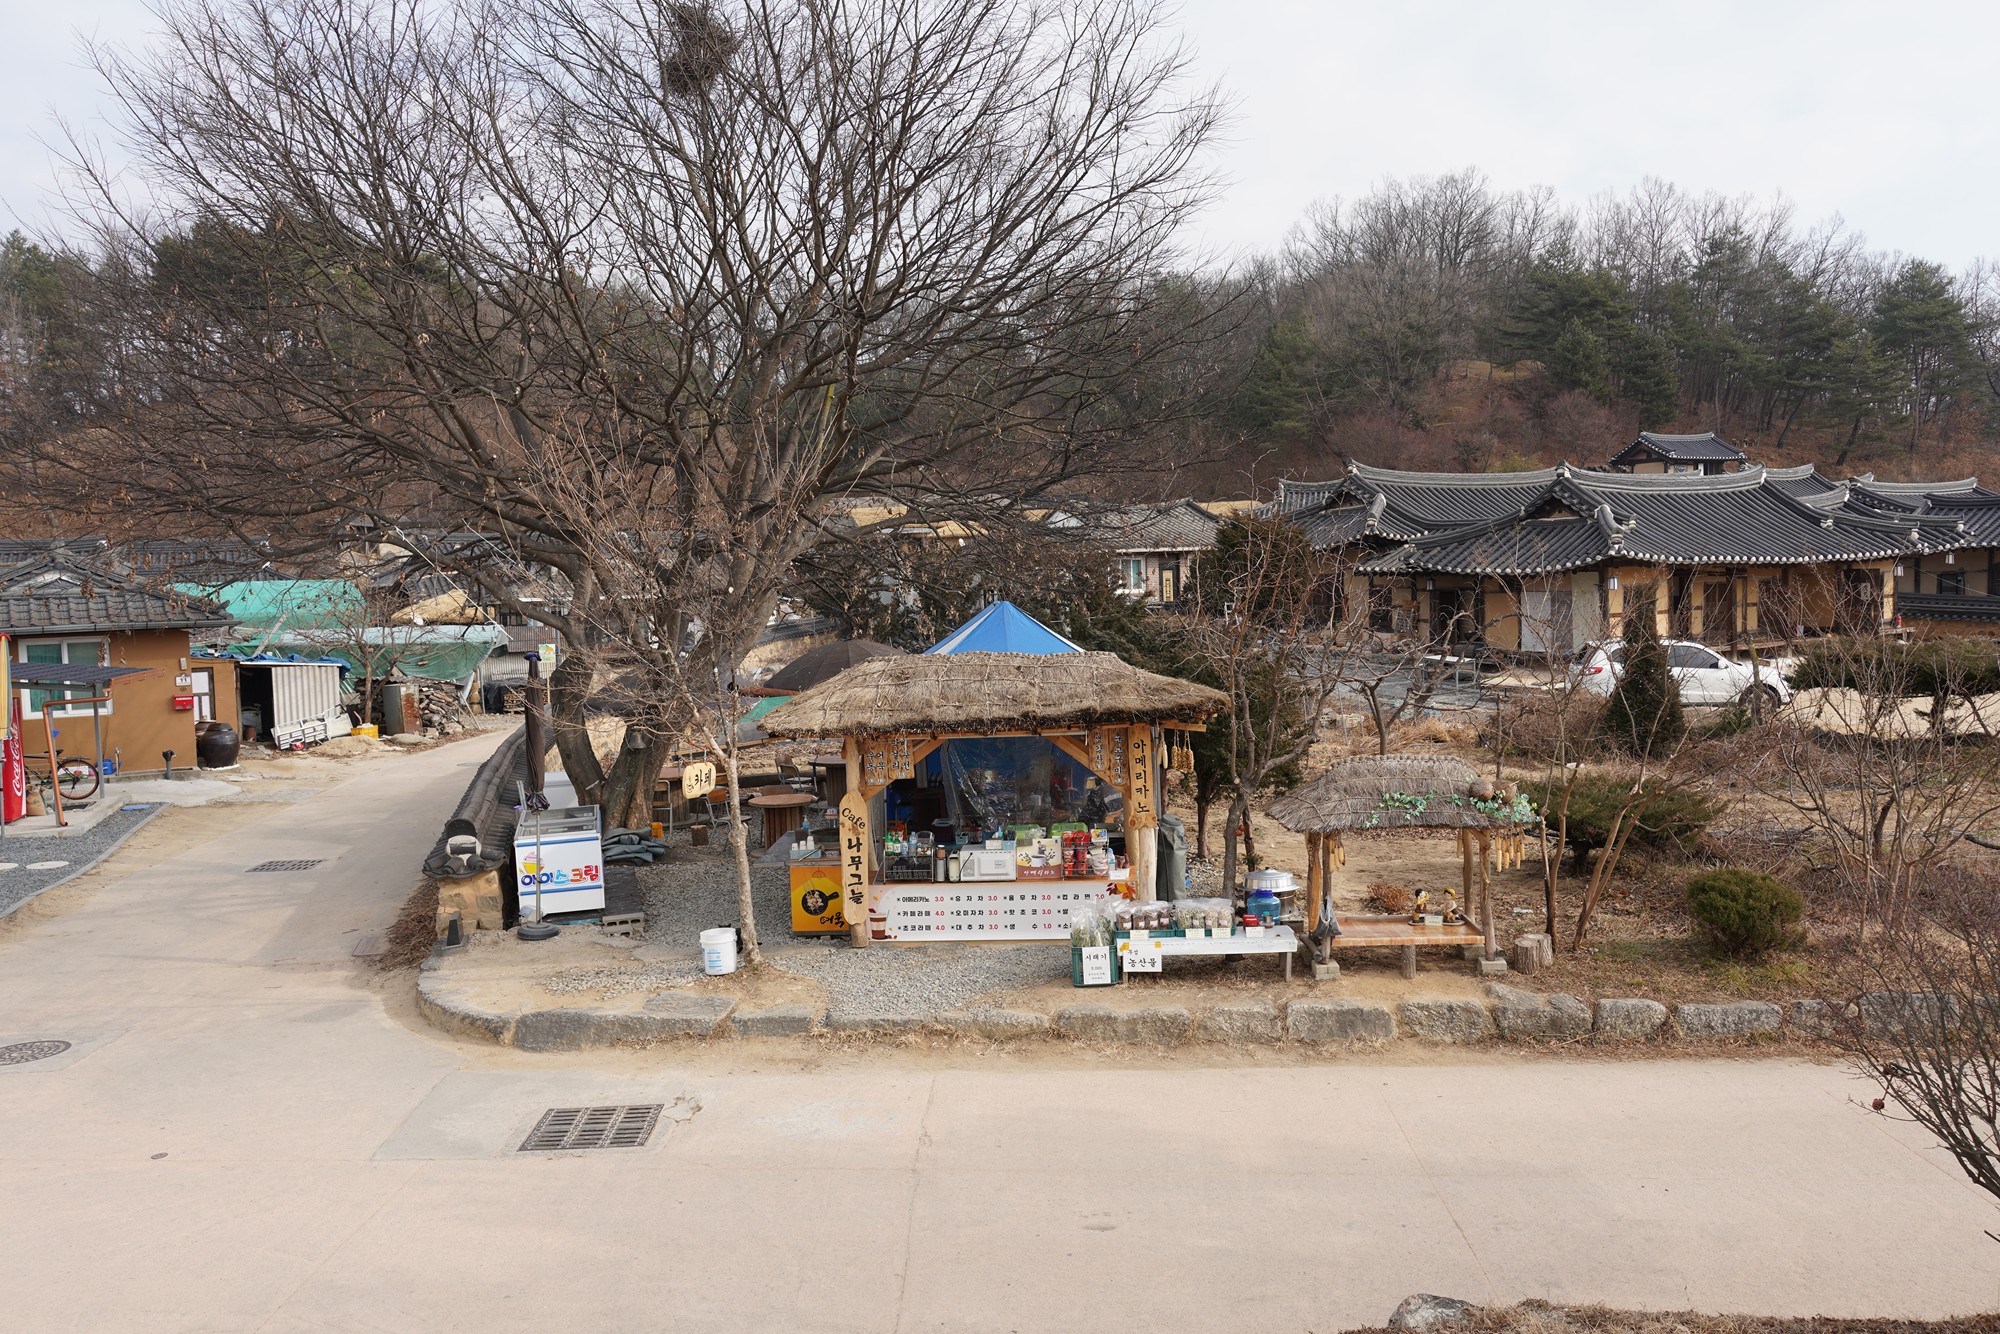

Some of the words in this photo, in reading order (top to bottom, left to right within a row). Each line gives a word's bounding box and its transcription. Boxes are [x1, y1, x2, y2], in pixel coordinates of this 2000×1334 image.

[866, 751, 875, 772] 우동
[876, 751, 885, 770] 어묵
[694, 767, 712, 790] 카페
[1133, 739, 1150, 814] 아메리카노
[841, 807, 866, 830] Cafe
[520, 865, 599, 886] 아이스크림
[847, 836, 864, 905] 나무그늘
[1023, 869, 1055, 877] 아메리카노
[820, 911, 845, 928] 어묵
[1085, 953, 1107, 961] 시래기
[1128, 957, 1157, 968] 농산물
